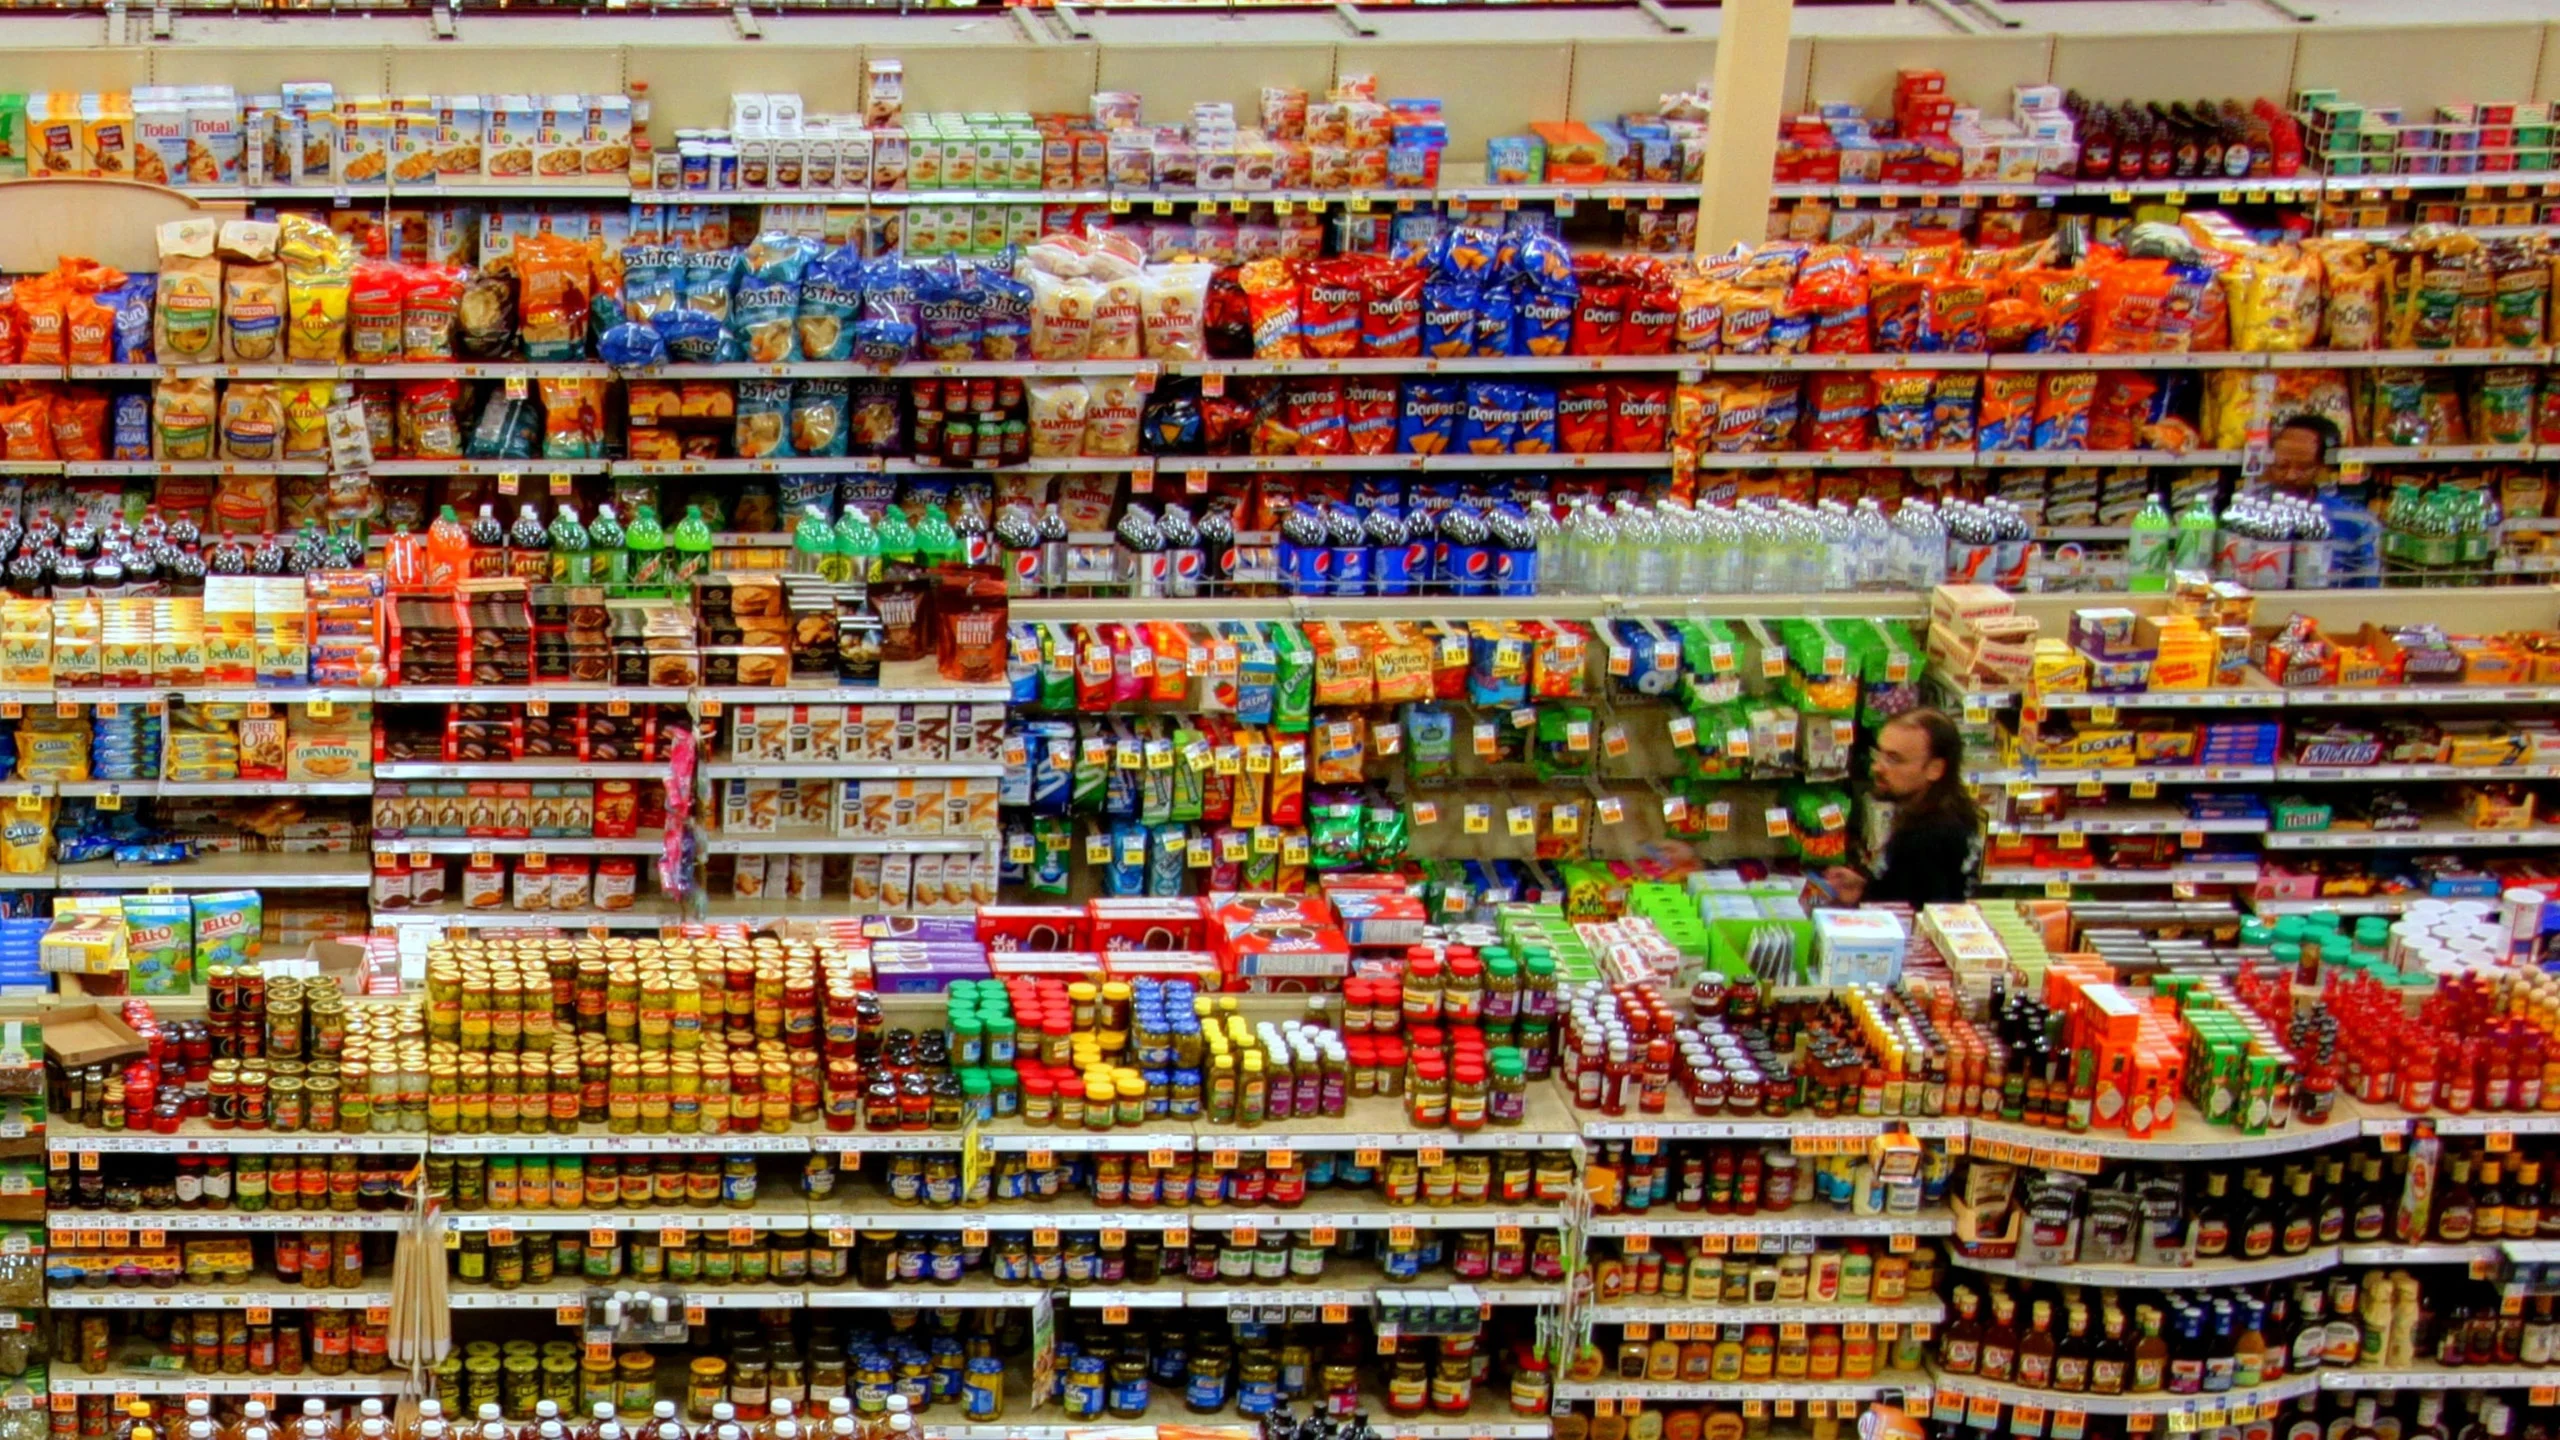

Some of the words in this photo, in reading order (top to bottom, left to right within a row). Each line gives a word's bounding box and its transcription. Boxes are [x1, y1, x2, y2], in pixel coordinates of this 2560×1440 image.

[142, 123, 180, 137] Total
[193, 119, 231, 133] Total
[1312, 286, 1361, 303] Doritos
[1368, 299, 1420, 317] Doritos
[1584, 308, 1621, 322] Dorit
[1044, 314, 1091, 331] SANTITAS
[1147, 314, 1194, 330] SANTITAS
[1425, 309, 1474, 326] Doritos
[1730, 307, 1771, 334] Fritos
[1090, 407, 1138, 421] SANTITAS
[1407, 400, 1456, 417] Doritos
[1468, 405, 1518, 423] Doritos
[1518, 407, 1554, 421] oritos
[1559, 398, 1608, 415] Doritos
[1621, 400, 1667, 418] Doritos
[1719, 404, 1765, 431] Fritos
[516, 559, 547, 576] MUG
[2306, 742, 2381, 763] SNICKERS
[1151, 1152, 1172, 1163] 1.99
[1420, 1152, 1440, 1162] 3.03
[142, 1233, 163, 1242] 4.99
[592, 1232, 614, 1242] 2.79
[1102, 1231, 1124, 1242] 1.99
[1165, 1231, 1187, 1242] 1.99
[248, 1311, 269, 1321] 2.49
